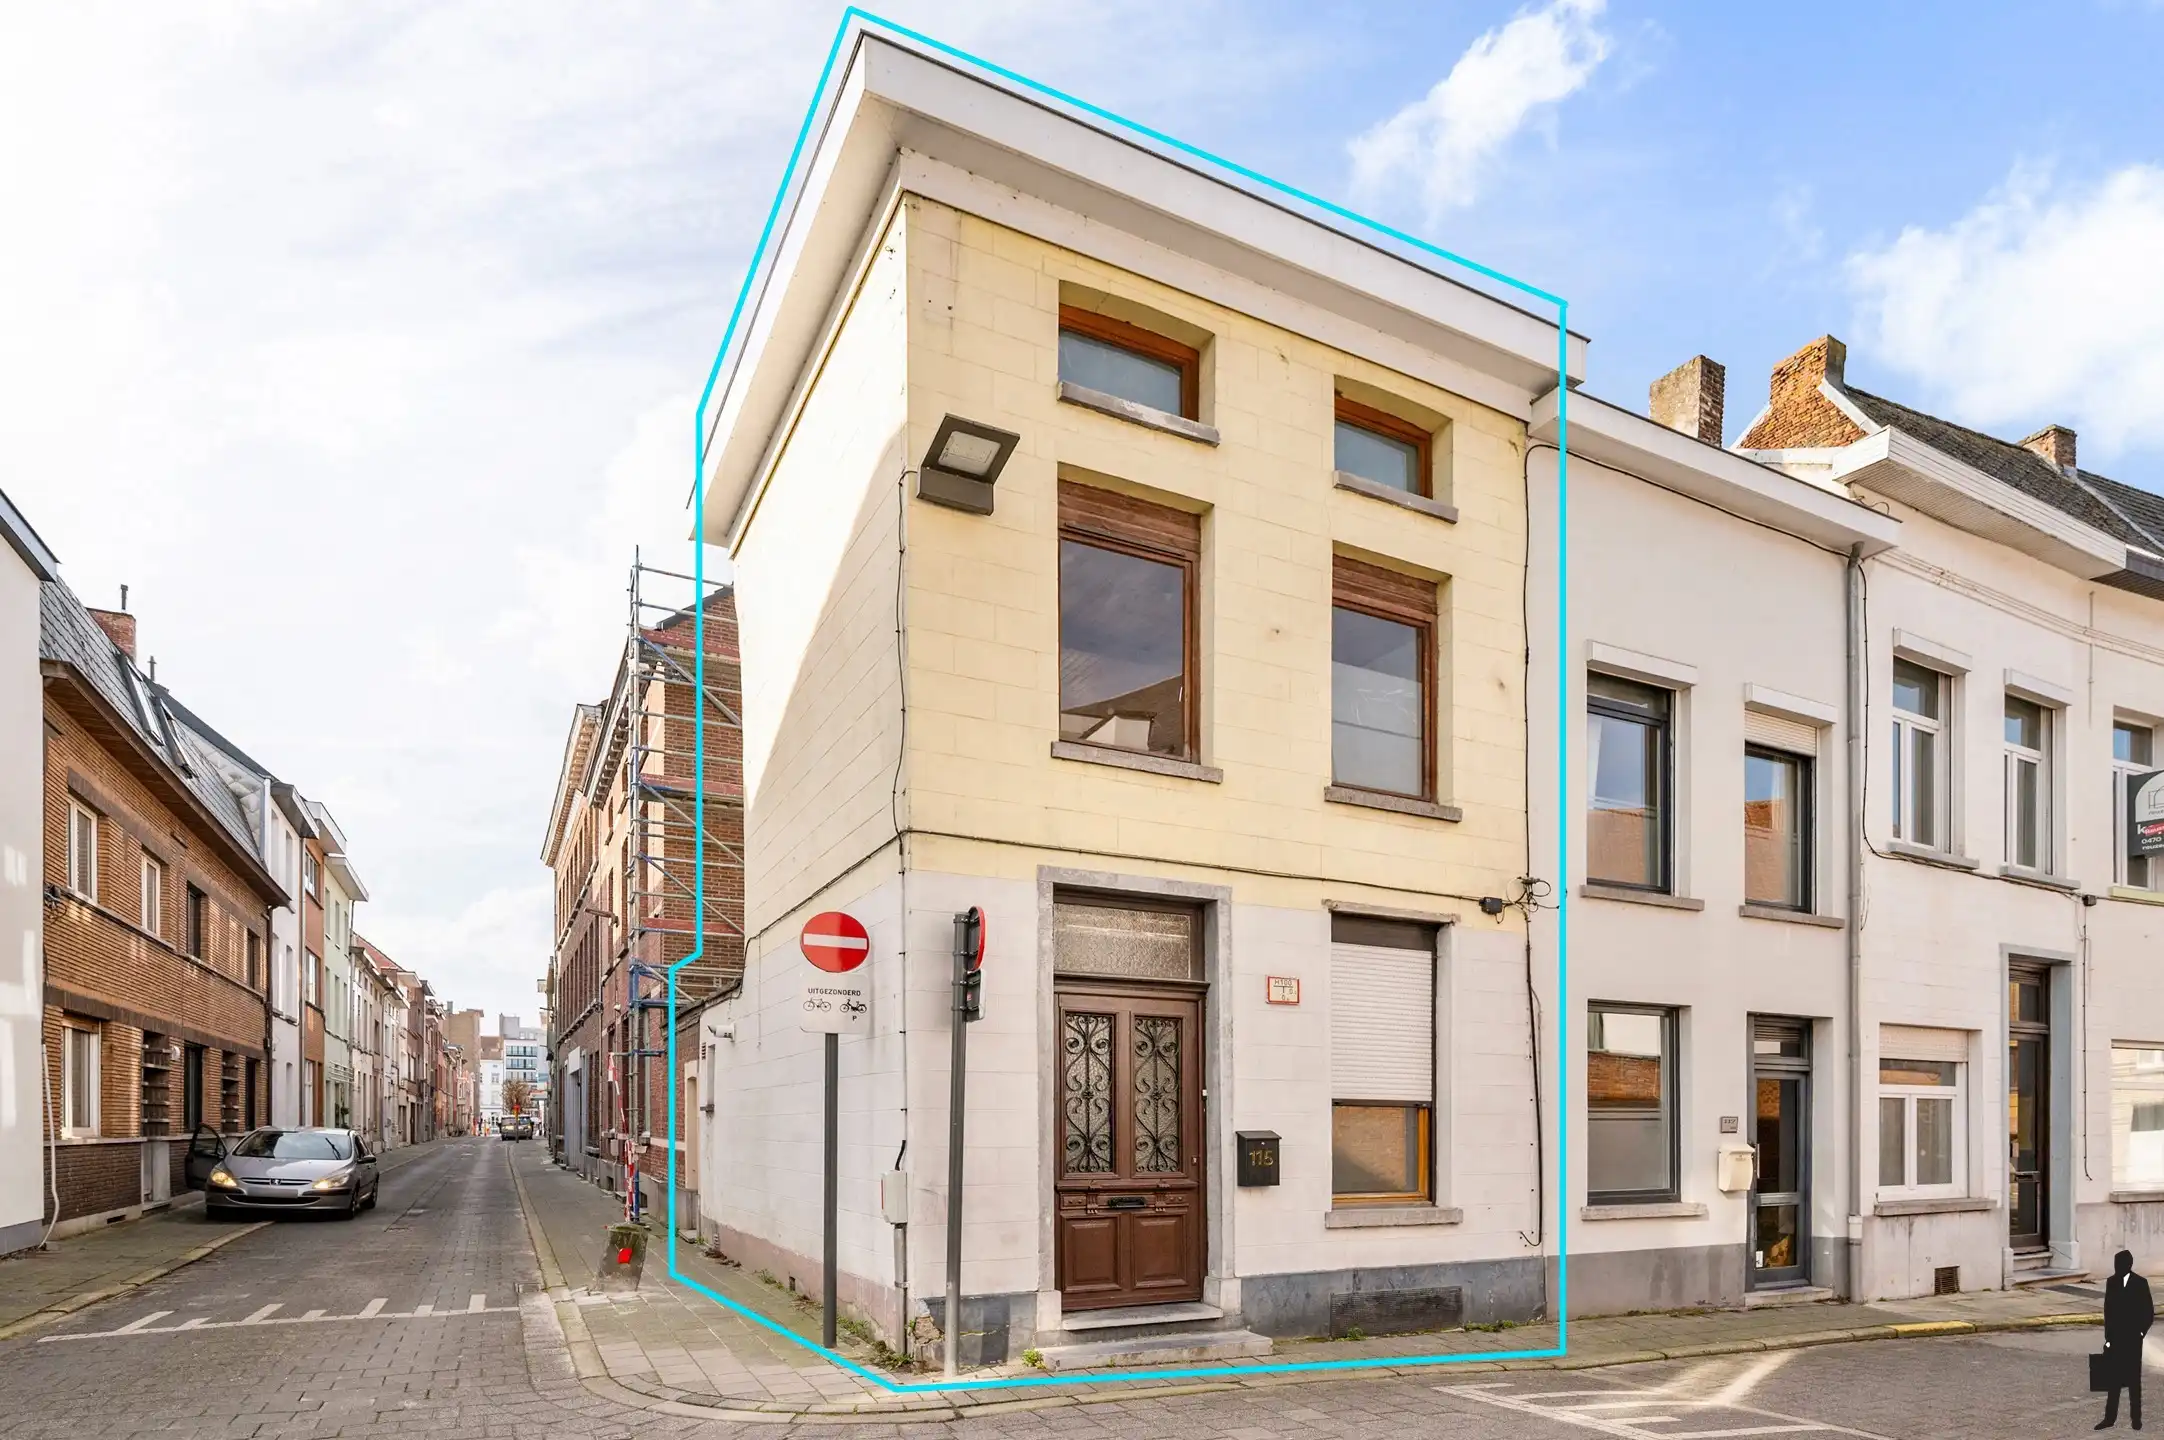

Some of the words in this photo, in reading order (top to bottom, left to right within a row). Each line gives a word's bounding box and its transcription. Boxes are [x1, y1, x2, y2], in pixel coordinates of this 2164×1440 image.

[2141, 836, 2162, 844] 0470
[807, 987, 862, 997] UITGEZONDERD
[1249, 1149, 1274, 1166] 115
